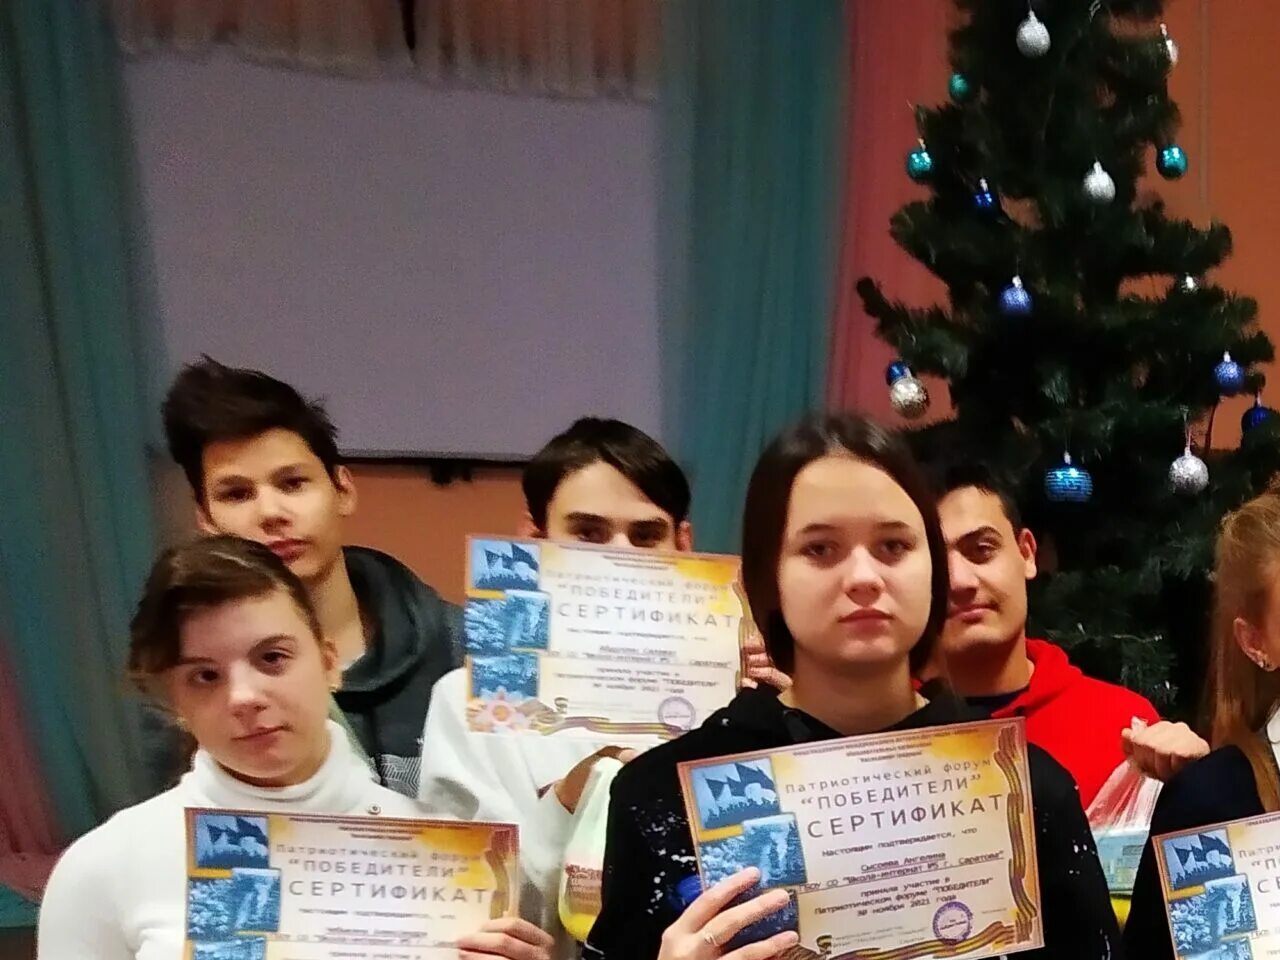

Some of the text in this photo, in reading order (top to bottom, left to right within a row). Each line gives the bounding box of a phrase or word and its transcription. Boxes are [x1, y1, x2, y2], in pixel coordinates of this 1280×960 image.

[558, 602, 735, 628] СЕРТИФИКАТ
[785, 758, 992, 794] Патриотический форум
[807, 793, 1003, 839] СЕРТИФИКАТ
[289, 880, 489, 904] СЕРТИФИКАТ
